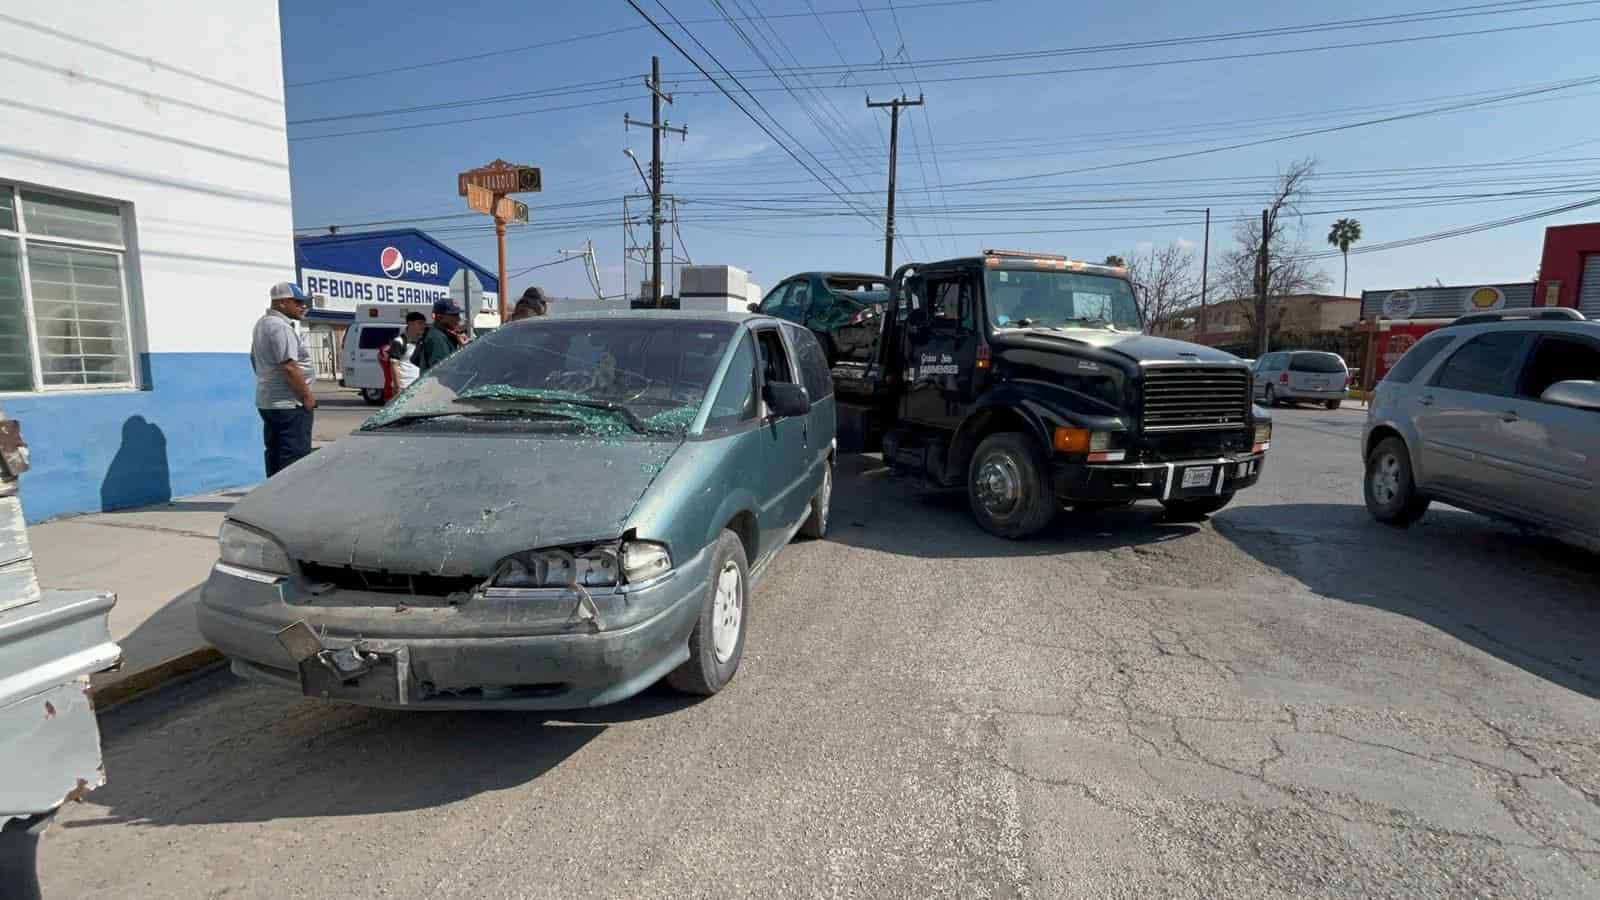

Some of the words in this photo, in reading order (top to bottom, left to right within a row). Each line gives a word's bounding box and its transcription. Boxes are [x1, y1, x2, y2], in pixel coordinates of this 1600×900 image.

[405, 260, 439, 276] pepsi
[307, 276, 373, 300] BEBIDAS
[376, 284, 394, 302] DE
